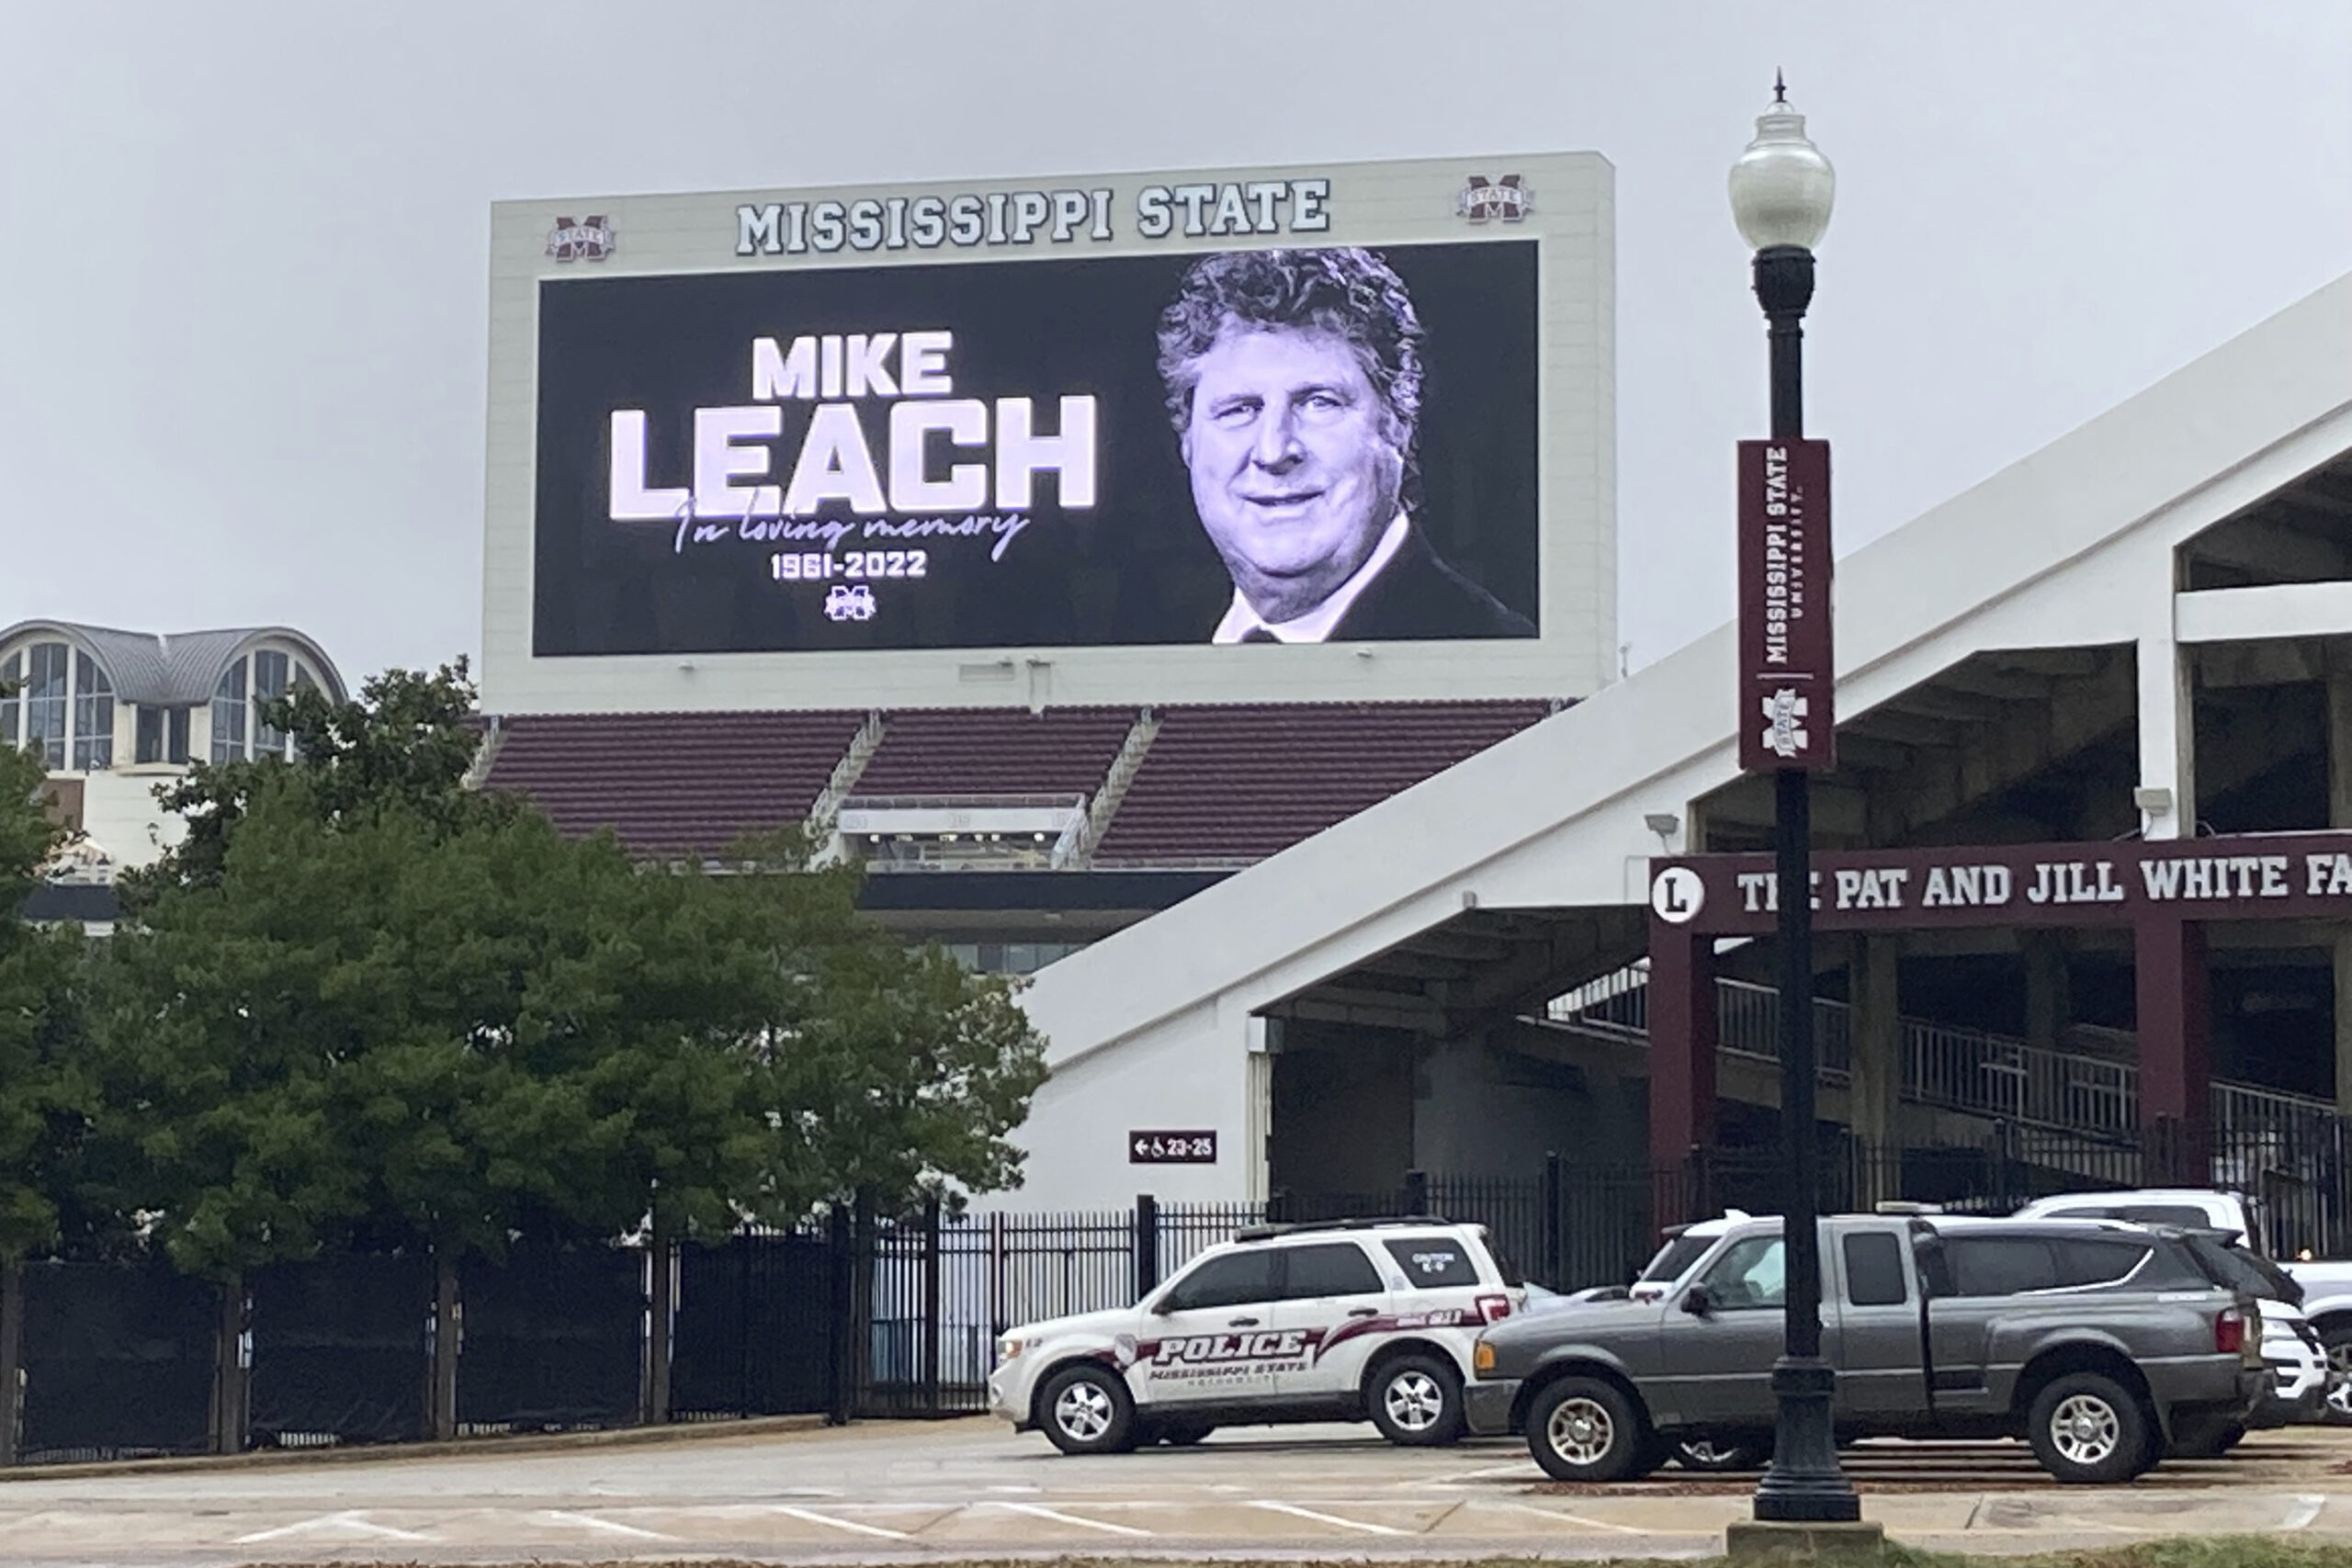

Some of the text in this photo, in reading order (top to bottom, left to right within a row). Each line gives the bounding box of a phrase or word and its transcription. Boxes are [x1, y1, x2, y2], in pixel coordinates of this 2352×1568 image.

[737, 179, 1329, 256] MISSISSIPPI STATE
[752, 331, 953, 400] MIKE
[609, 395, 1096, 519] LEACH
[675, 488, 1030, 561] In loving memory
[1766, 446, 1788, 664] MISSISSIPPI STATE
[771, 551, 926, 579] 1961-2022
[1665, 877, 1688, 912] L
[1836, 869, 1907, 908] PAT
[1922, 865, 2011, 906] AND
[2028, 862, 2124, 903] JILL
[2139, 855, 2289, 900] WHITE
[1167, 1138, 1212, 1156] 23-25
[1153, 1329, 1308, 1365] POLICE
